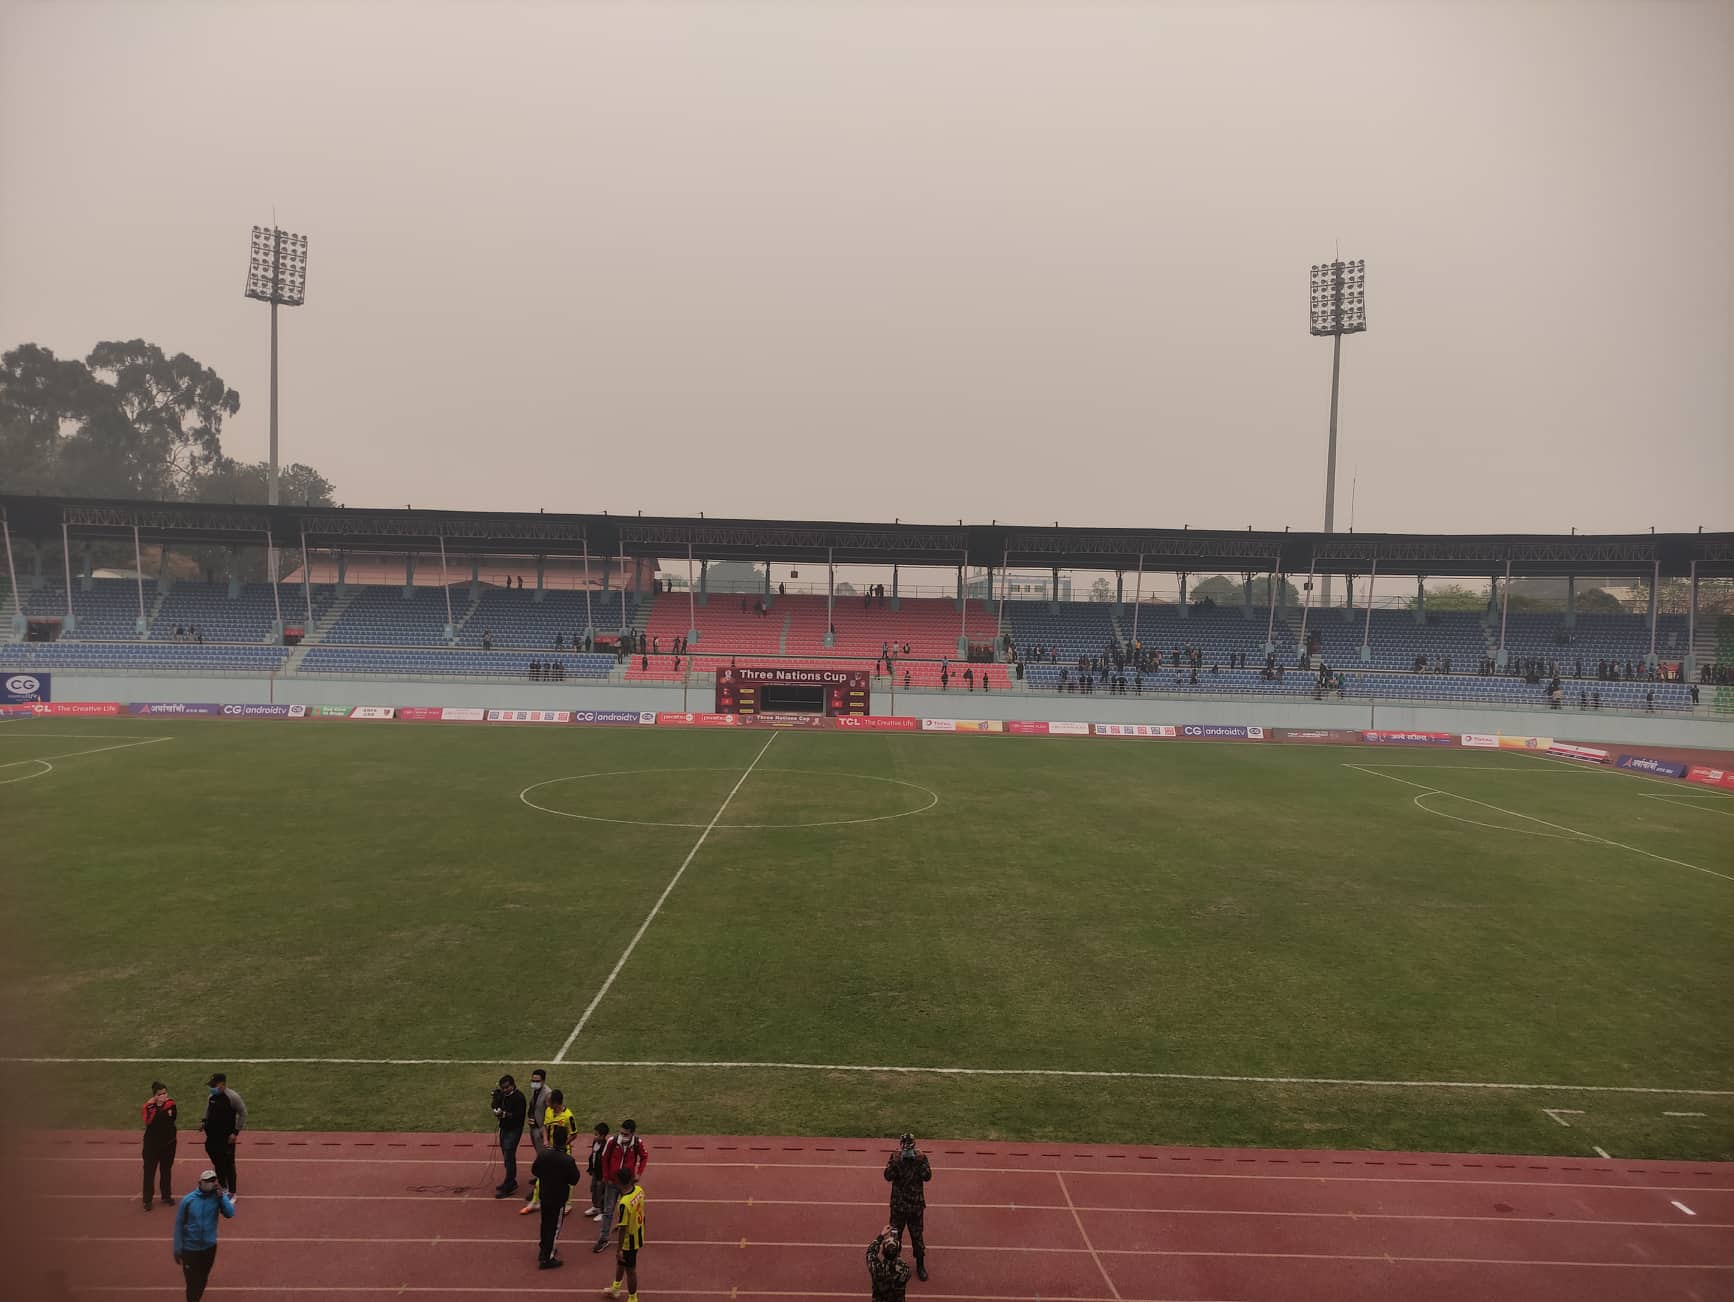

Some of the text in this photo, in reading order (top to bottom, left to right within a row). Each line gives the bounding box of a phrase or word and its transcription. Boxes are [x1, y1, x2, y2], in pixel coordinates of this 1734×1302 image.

[740, 669, 847, 683] Three Nations Cup
[11, 679, 35, 689] CG
[57, 704, 71, 712] The
[72, 704, 101, 712] Creative
[103, 704, 116, 712] Life
[224, 705, 242, 714] CG
[576, 712, 594, 721] CG
[838, 717, 914, 727] TCL The Creative Life
[1184, 726, 1202, 735] CG
